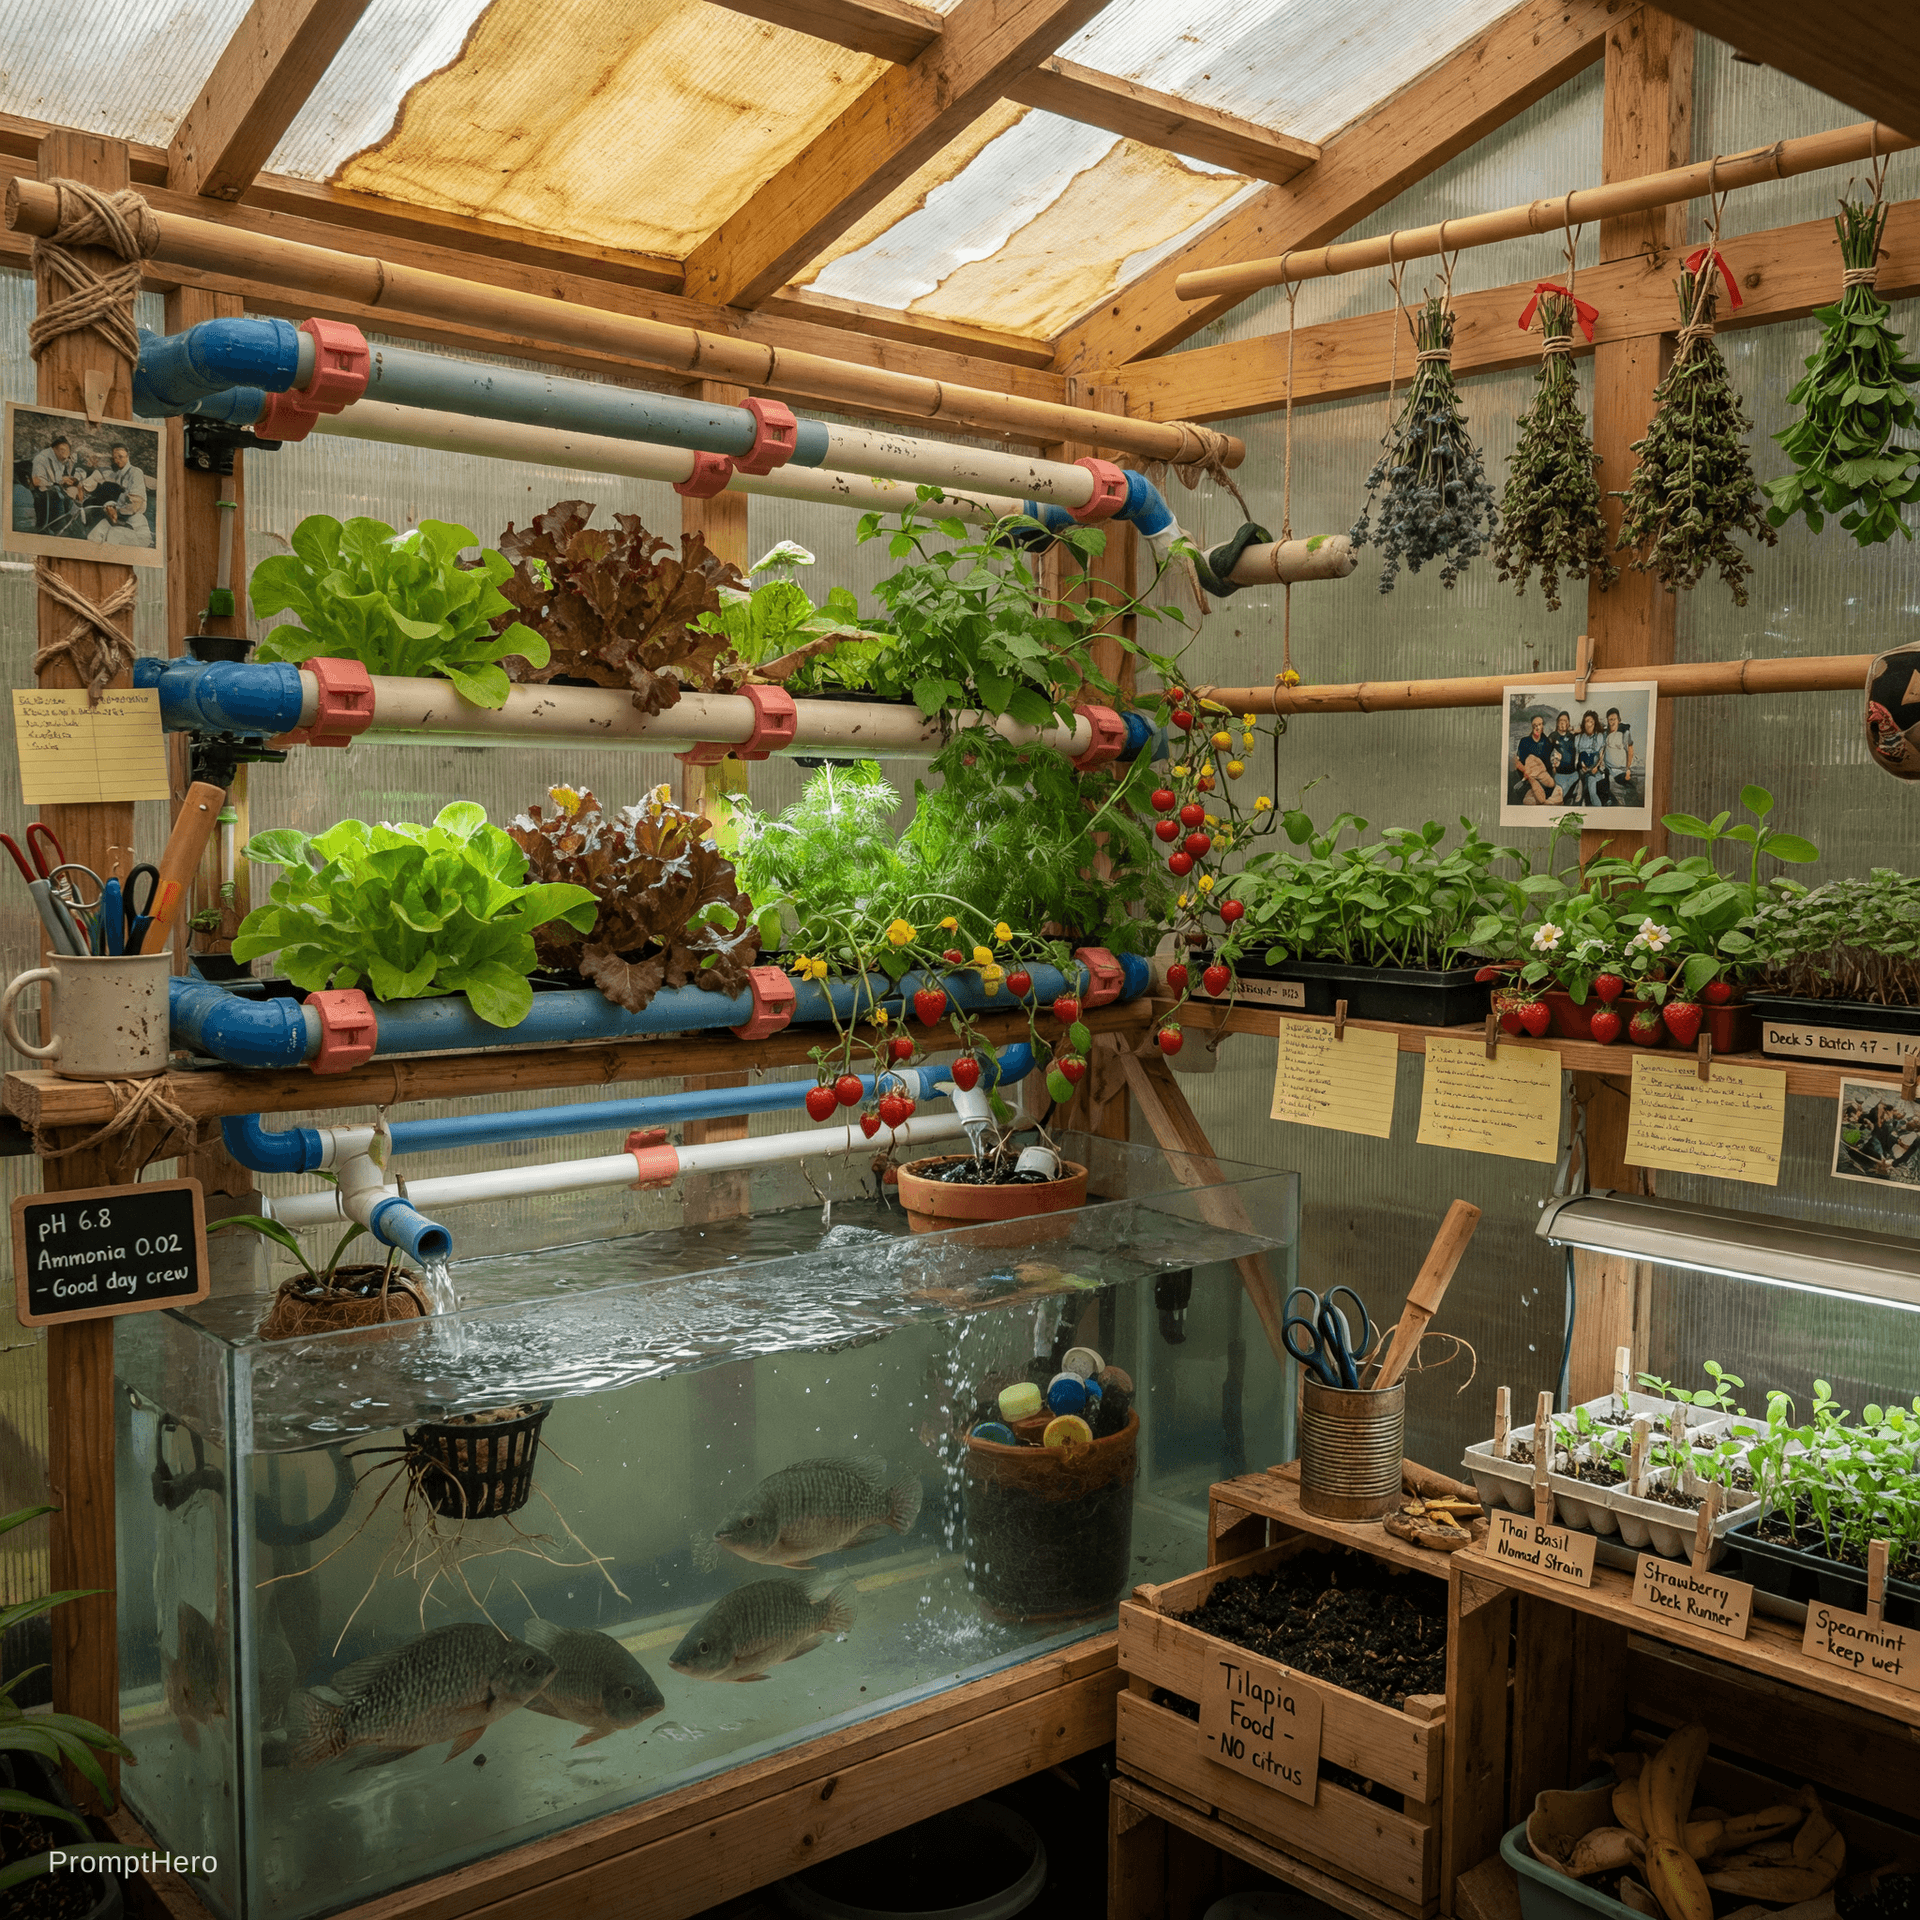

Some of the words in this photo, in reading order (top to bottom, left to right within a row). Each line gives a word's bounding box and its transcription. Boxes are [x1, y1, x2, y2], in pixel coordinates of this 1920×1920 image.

[1770, 1030, 1801, 1046] Deck
[1805, 1035, 1813, 1047] 5
[1819, 1036, 1855, 1050] Batch
[39, 1213, 66, 1242] pH
[79, 1208, 112, 1231] 6.8
[38, 1246, 126, 1271] Ammonia
[135, 1234, 183, 1256] 0.02
[106, 1271, 137, 1295] day
[146, 1266, 189, 1284] crew
[1499, 1518, 1528, 1540] Thai
[1535, 1526, 1569, 1552] Basil
[1544, 1553, 1582, 1577] Strain
[1644, 1561, 1729, 1609] Strawberry
[1816, 1610, 1906, 1651] Spearmint
[1872, 1657, 1903, 1675] wet
[1219, 1662, 1296, 1716] Tilapia
[1231, 1700, 1274, 1741] Food
[1252, 1751, 1302, 1786] citrus
